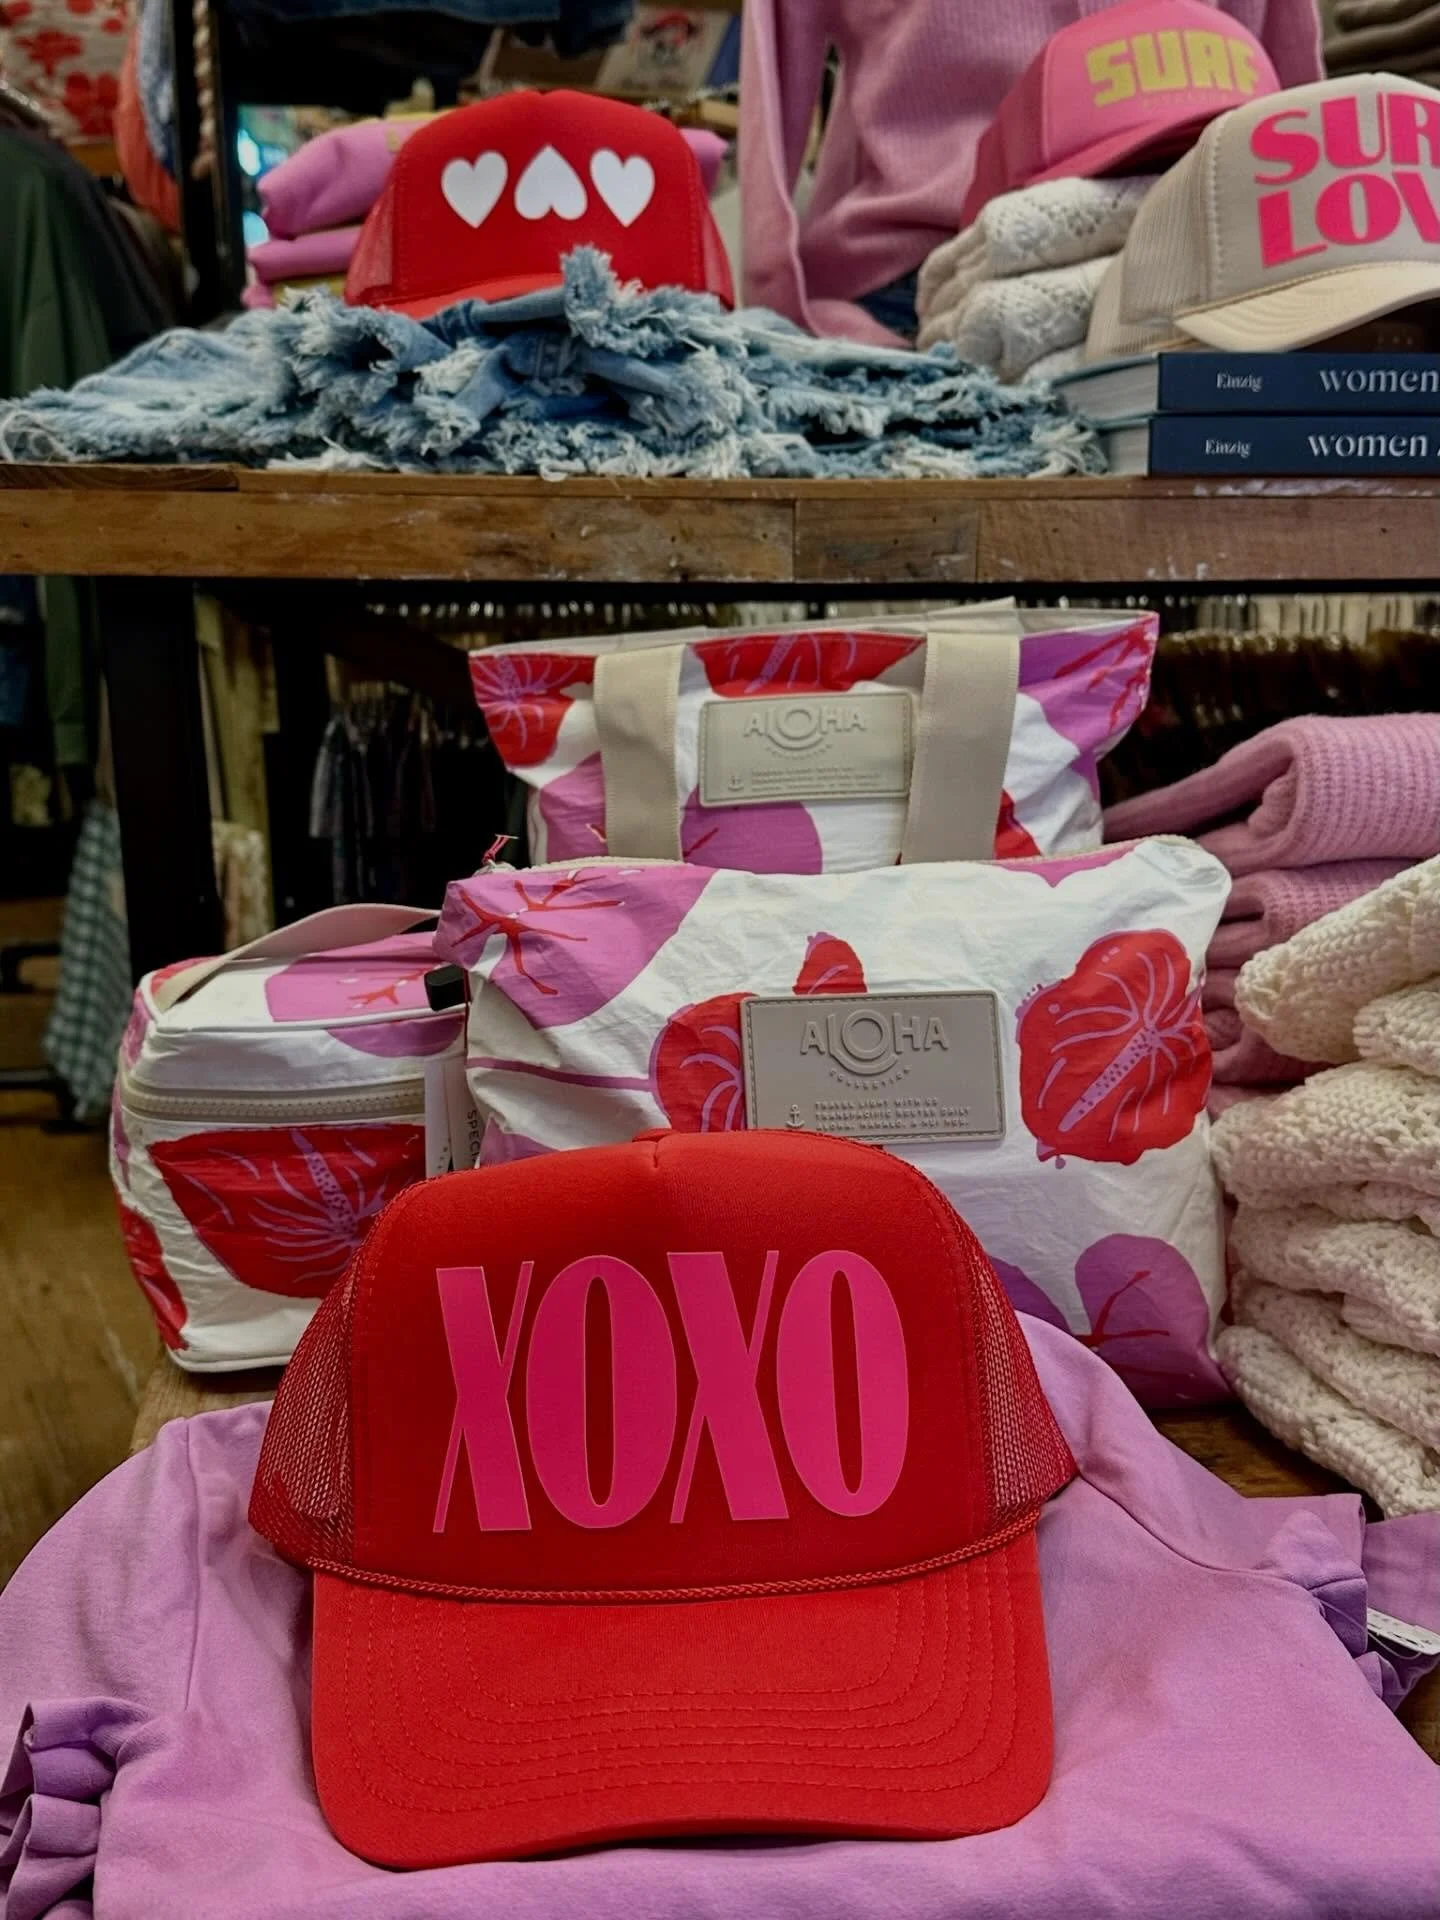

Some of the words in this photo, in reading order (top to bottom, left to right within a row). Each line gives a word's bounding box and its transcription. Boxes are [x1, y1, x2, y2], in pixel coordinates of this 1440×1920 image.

[1087, 31, 1257, 107] SURF
[1216, 372, 1263, 393] Einzig
[1320, 369, 1440, 393] women
[1205, 439, 1250, 458] Einzig
[1308, 434, 1428, 457] women
[743, 703, 867, 751] ALOHA
[799, 1009, 949, 1076] ALOHA
[467, 1109, 481, 1163] SPECI
[433, 1250, 909, 1533] XOXO
